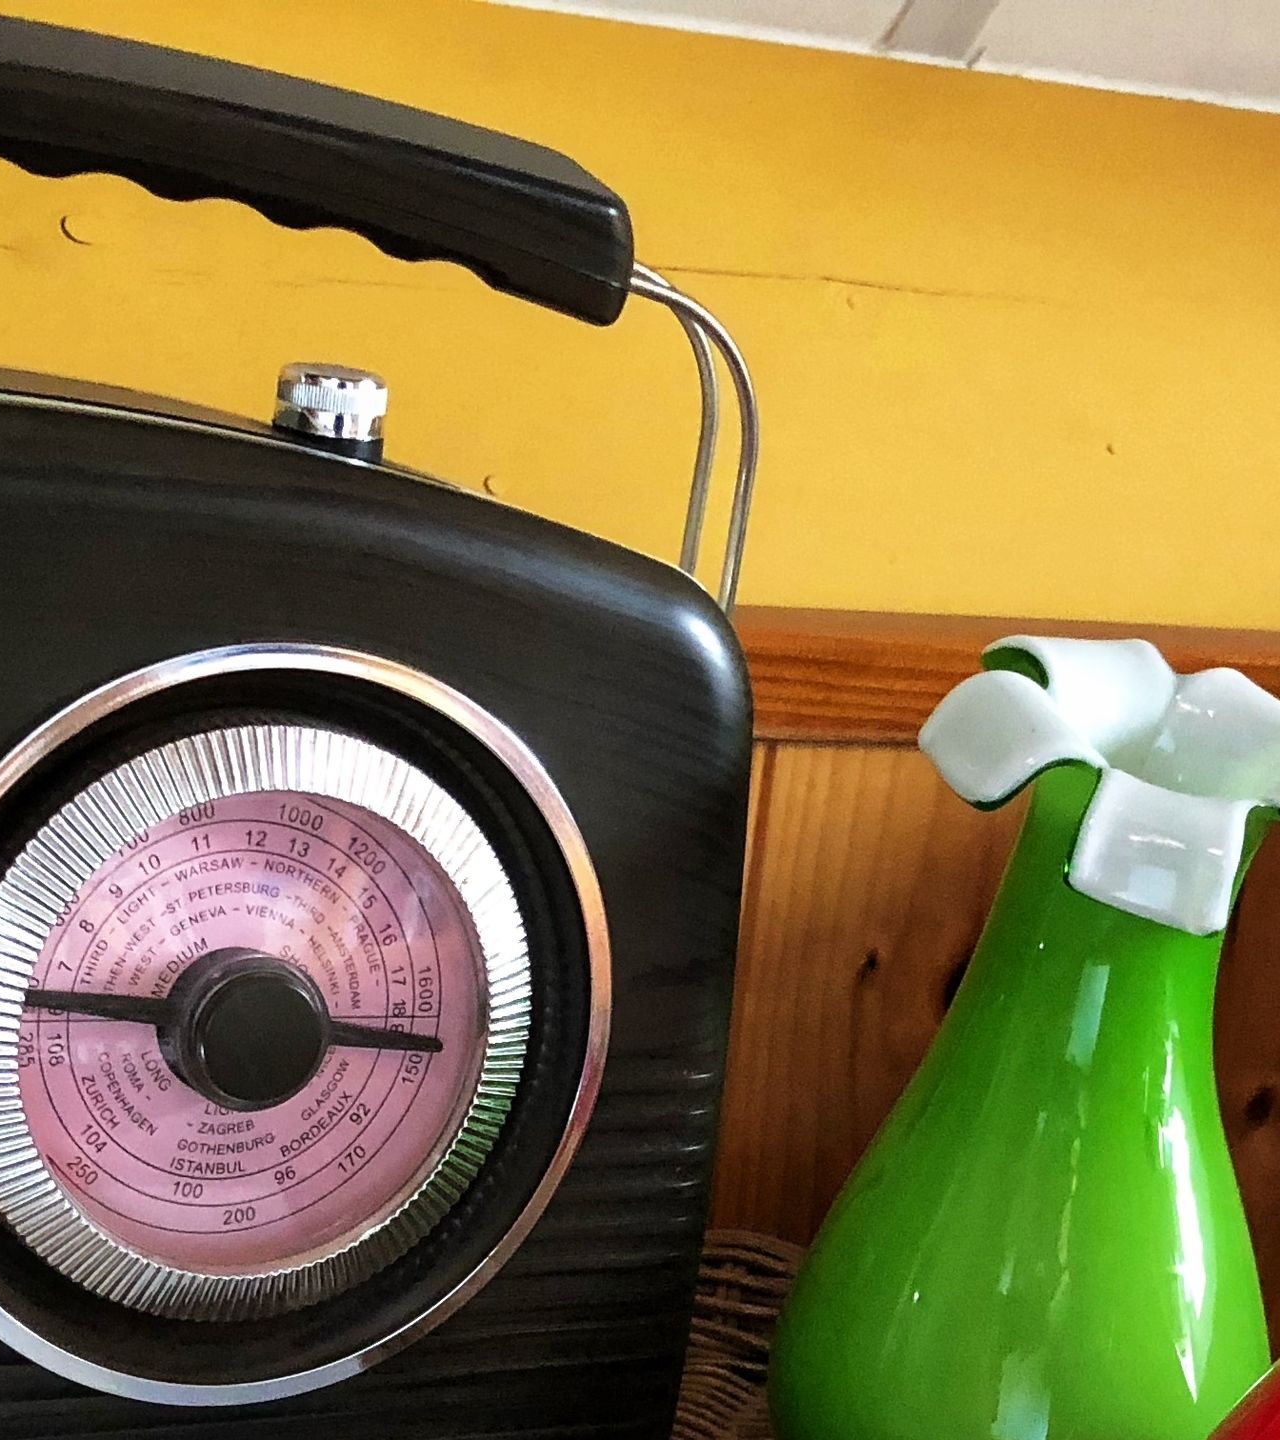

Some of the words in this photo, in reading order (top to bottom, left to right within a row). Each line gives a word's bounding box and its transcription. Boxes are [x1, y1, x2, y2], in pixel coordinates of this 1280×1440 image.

[191, 833, 211, 852] 11
[245, 830, 268, 848] 12
[289, 838, 311, 858] 13
[138, 854, 161, 875] 10
[328, 857, 347, 880] 14
[108, 883, 123, 899] 9
[188, 882, 280, 902] PETERSBURG
[358, 887, 378, 910] 15
[179, 801, 215, 826] 800
[277, 803, 323, 832] 1000
[348, 836, 386, 876] 1200
[418, 966, 434, 1012] 1600
[79, 919, 95, 934] 8
[80, 939, 108, 986] THIRD
[116, 886, 156, 925] LIGHT
[175, 857, 245, 882] WARSAW
[264, 858, 342, 905] NORTHERN
[350, 915, 381, 975] PRAGUE
[379, 923, 398, 947] 16
[128, 946, 158, 986] WEST
[170, 906, 227, 937] GENEVA
[245, 905, 295, 930] VIENNA
[308, 935, 341, 996] HELSINKI
[57, 961, 73, 972] 7
[151, 937, 209, 999] MEDIUM
[391, 966, 407, 986] 17
[392, 998, 407, 1017] 18
[141, 1050, 171, 1092] LONG
[98, 1052, 158, 1136] COPENHAGEN
[177, 1132, 276, 1156] GOTHENBURG
[301, 1058, 350, 1121] GLASGOW
[121, 1053, 145, 1093] ROMA
[197, 1119, 255, 1135] ZAGREB
[47, 1033, 65, 1067] 108
[81, 1123, 108, 1154] 104
[173, 1181, 204, 1198] 100
[274, 1166, 296, 1185] 96
[349, 1103, 371, 1126] 92
[81, 1075, 121, 1131] ZURICH
[170, 1157, 246, 1175] ISTANBUL
[280, 1091, 353, 1158] BORDEAUX
[66, 1155, 99, 1187] 250
[223, 1206, 256, 1226] 200
[337, 1145, 366, 1174] 170
[402, 1053, 423, 1085] 150
